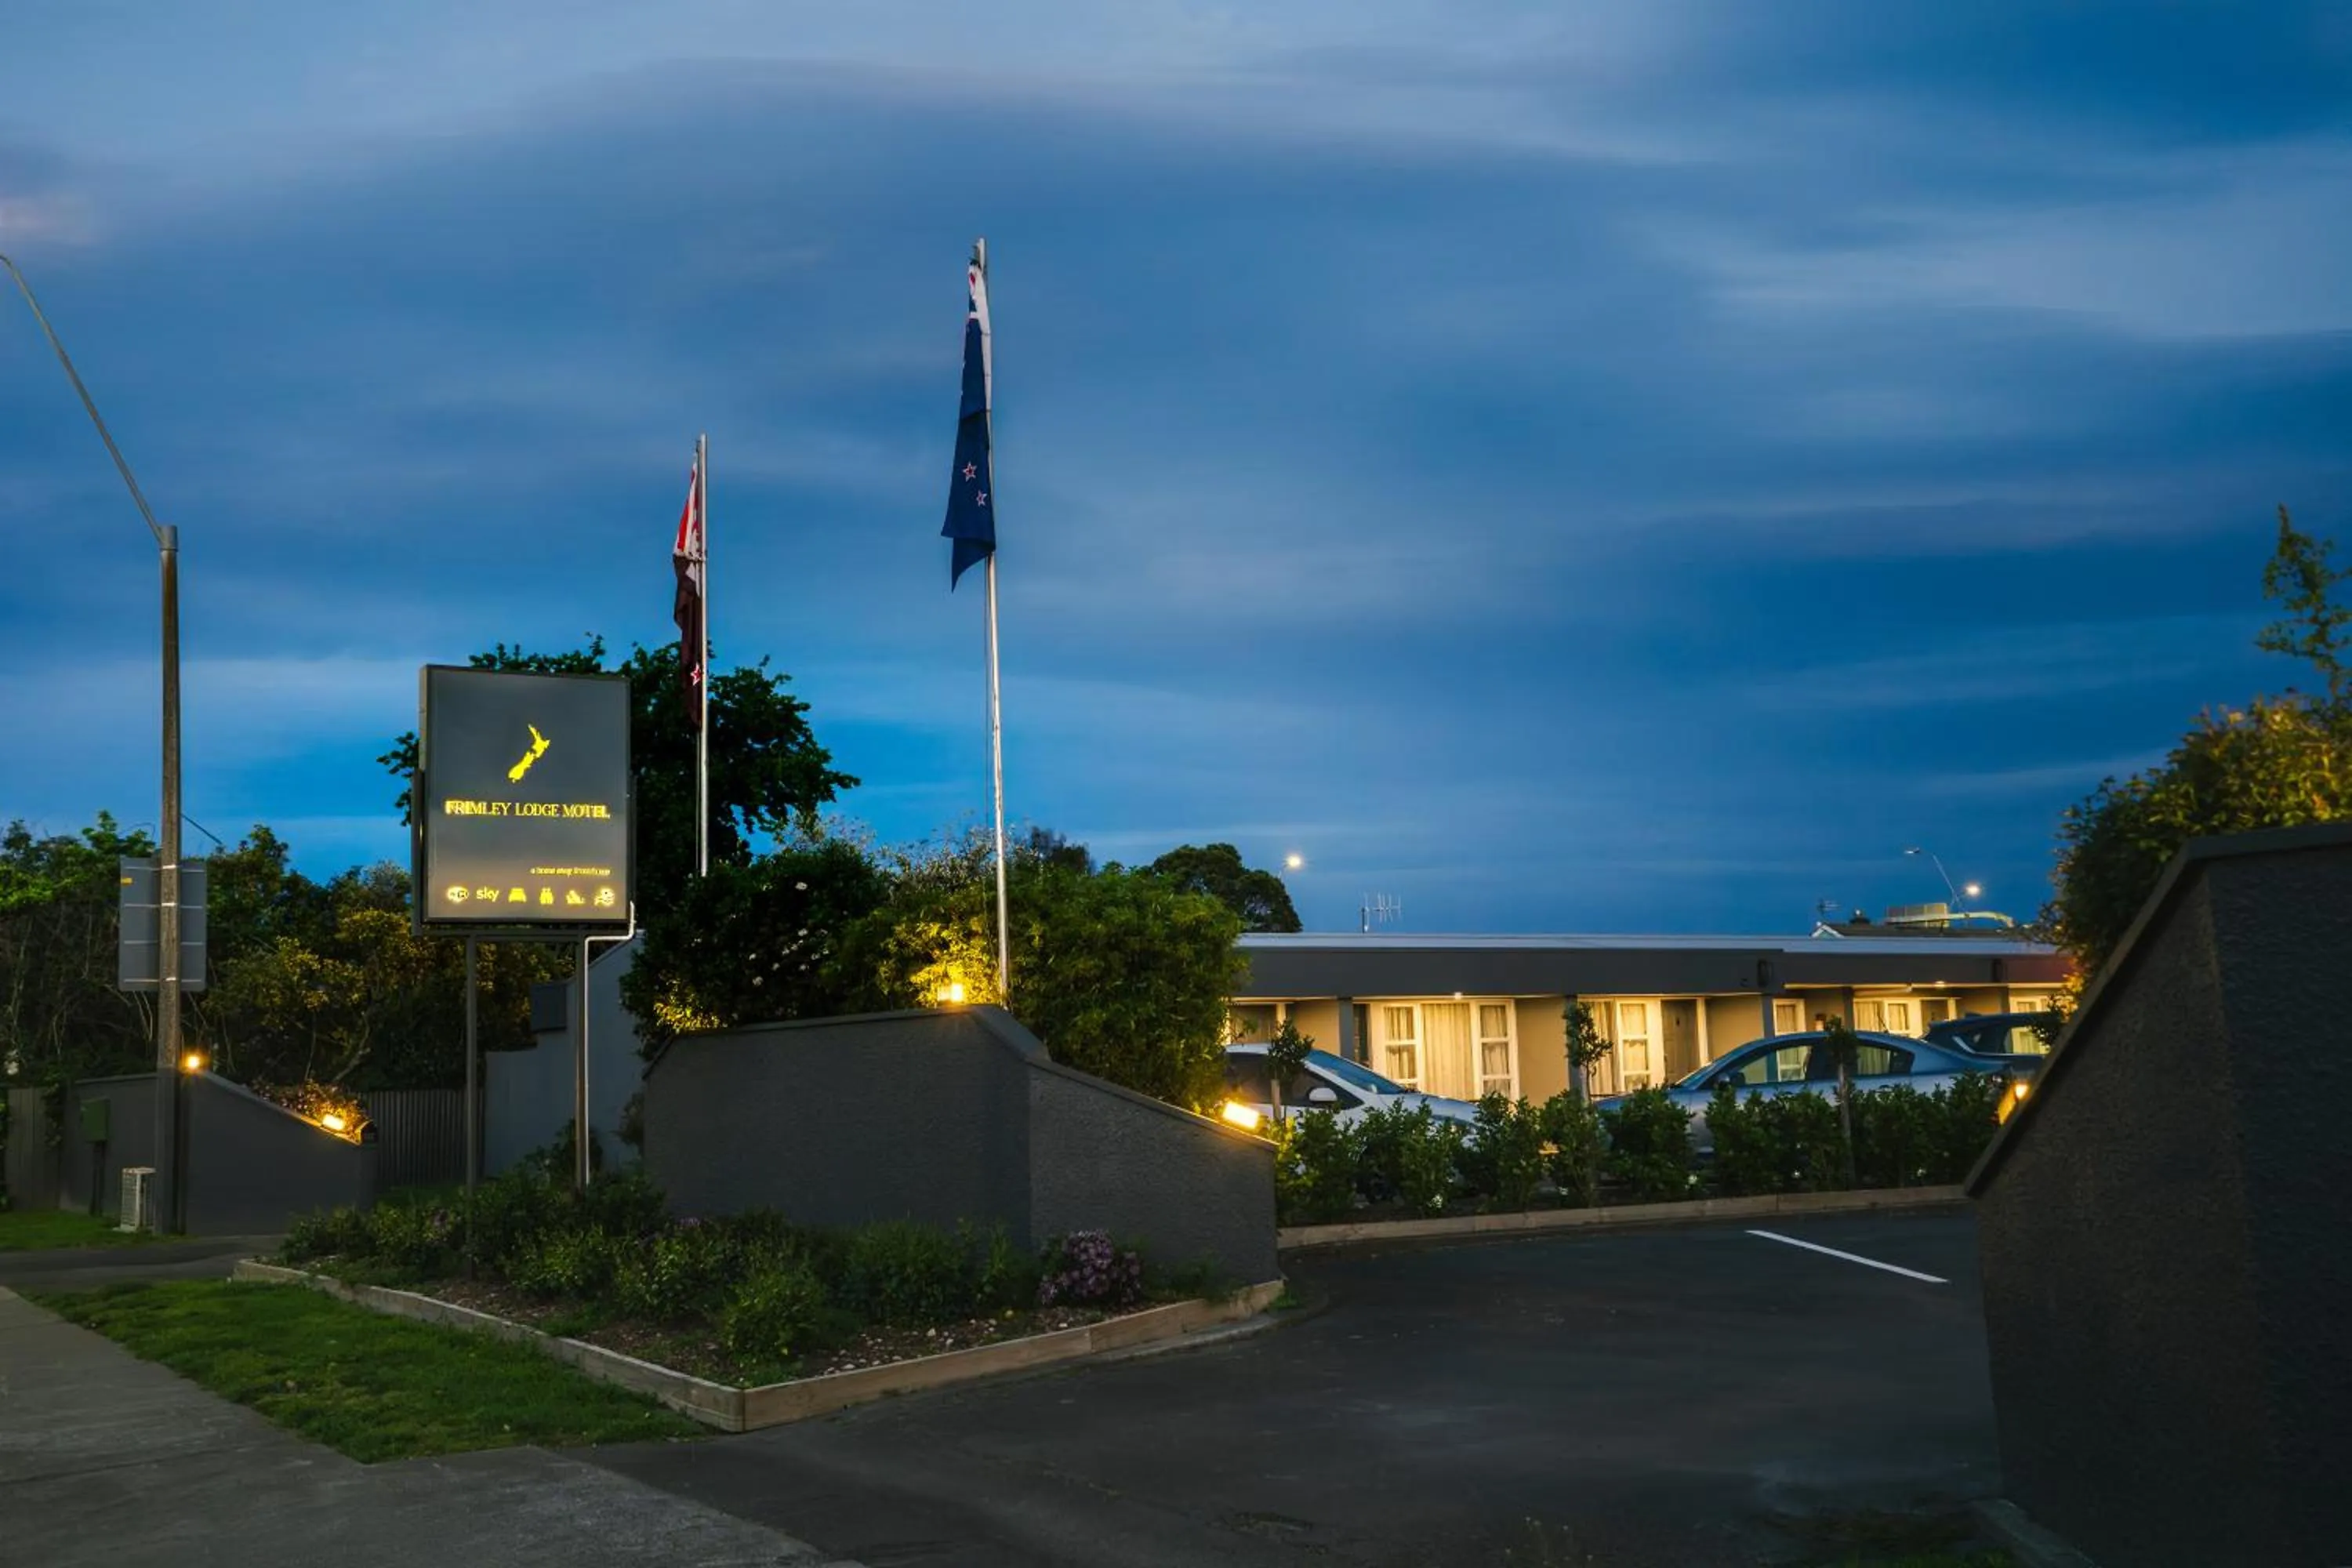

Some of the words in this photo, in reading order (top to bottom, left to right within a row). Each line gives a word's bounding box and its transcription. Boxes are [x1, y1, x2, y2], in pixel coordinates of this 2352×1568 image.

[445, 800, 511, 815] FRIMLEY
[514, 802, 559, 816] LODGE
[561, 803, 611, 818] MOTEL
[476, 885, 499, 902] sky
